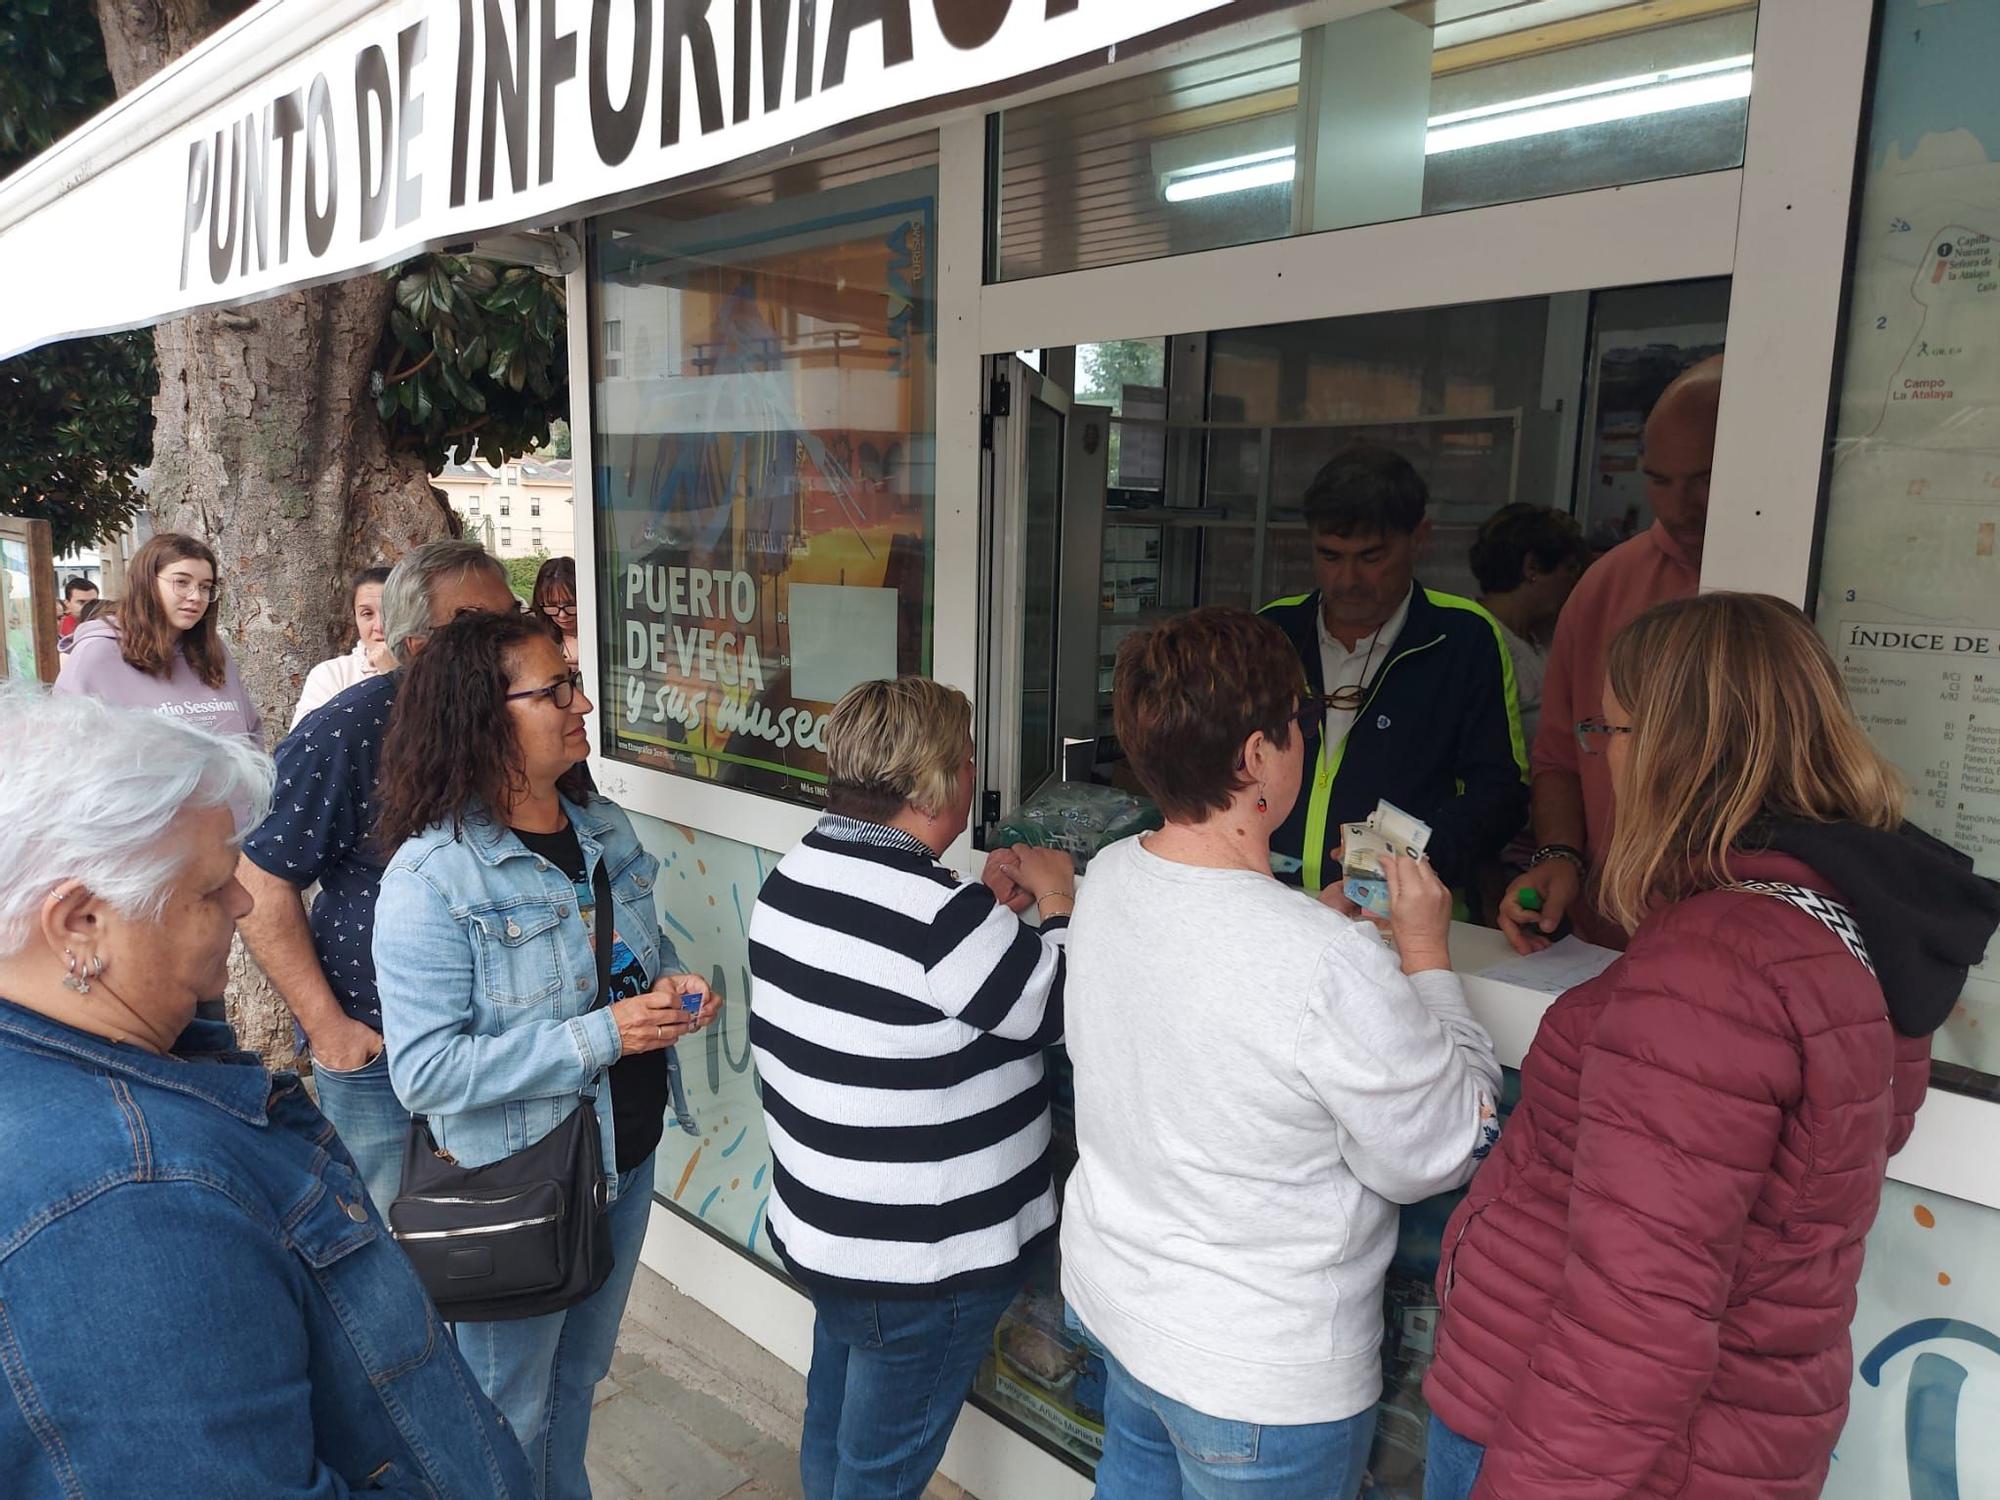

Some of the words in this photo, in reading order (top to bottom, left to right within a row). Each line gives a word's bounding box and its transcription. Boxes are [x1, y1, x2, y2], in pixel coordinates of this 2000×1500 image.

[180, 72, 338, 292] PUNTO
[355, 16, 429, 243] DE
[1876, 316, 1888, 330] 2
[1903, 378, 1945, 389] Campo
[1912, 389, 1954, 400] Atalaya
[625, 563, 756, 624] PUERTO
[1846, 590, 1856, 602] 3
[1849, 625, 1945, 652] ÍNDICE
[1953, 635, 1990, 654] DE
[625, 619, 668, 674] DE
[673, 625, 765, 691] VEGA
[626, 675, 646, 724] y
[652, 684, 709, 730] sus
[717, 692, 829, 753] museo
[1969, 714, 1976, 722] P
